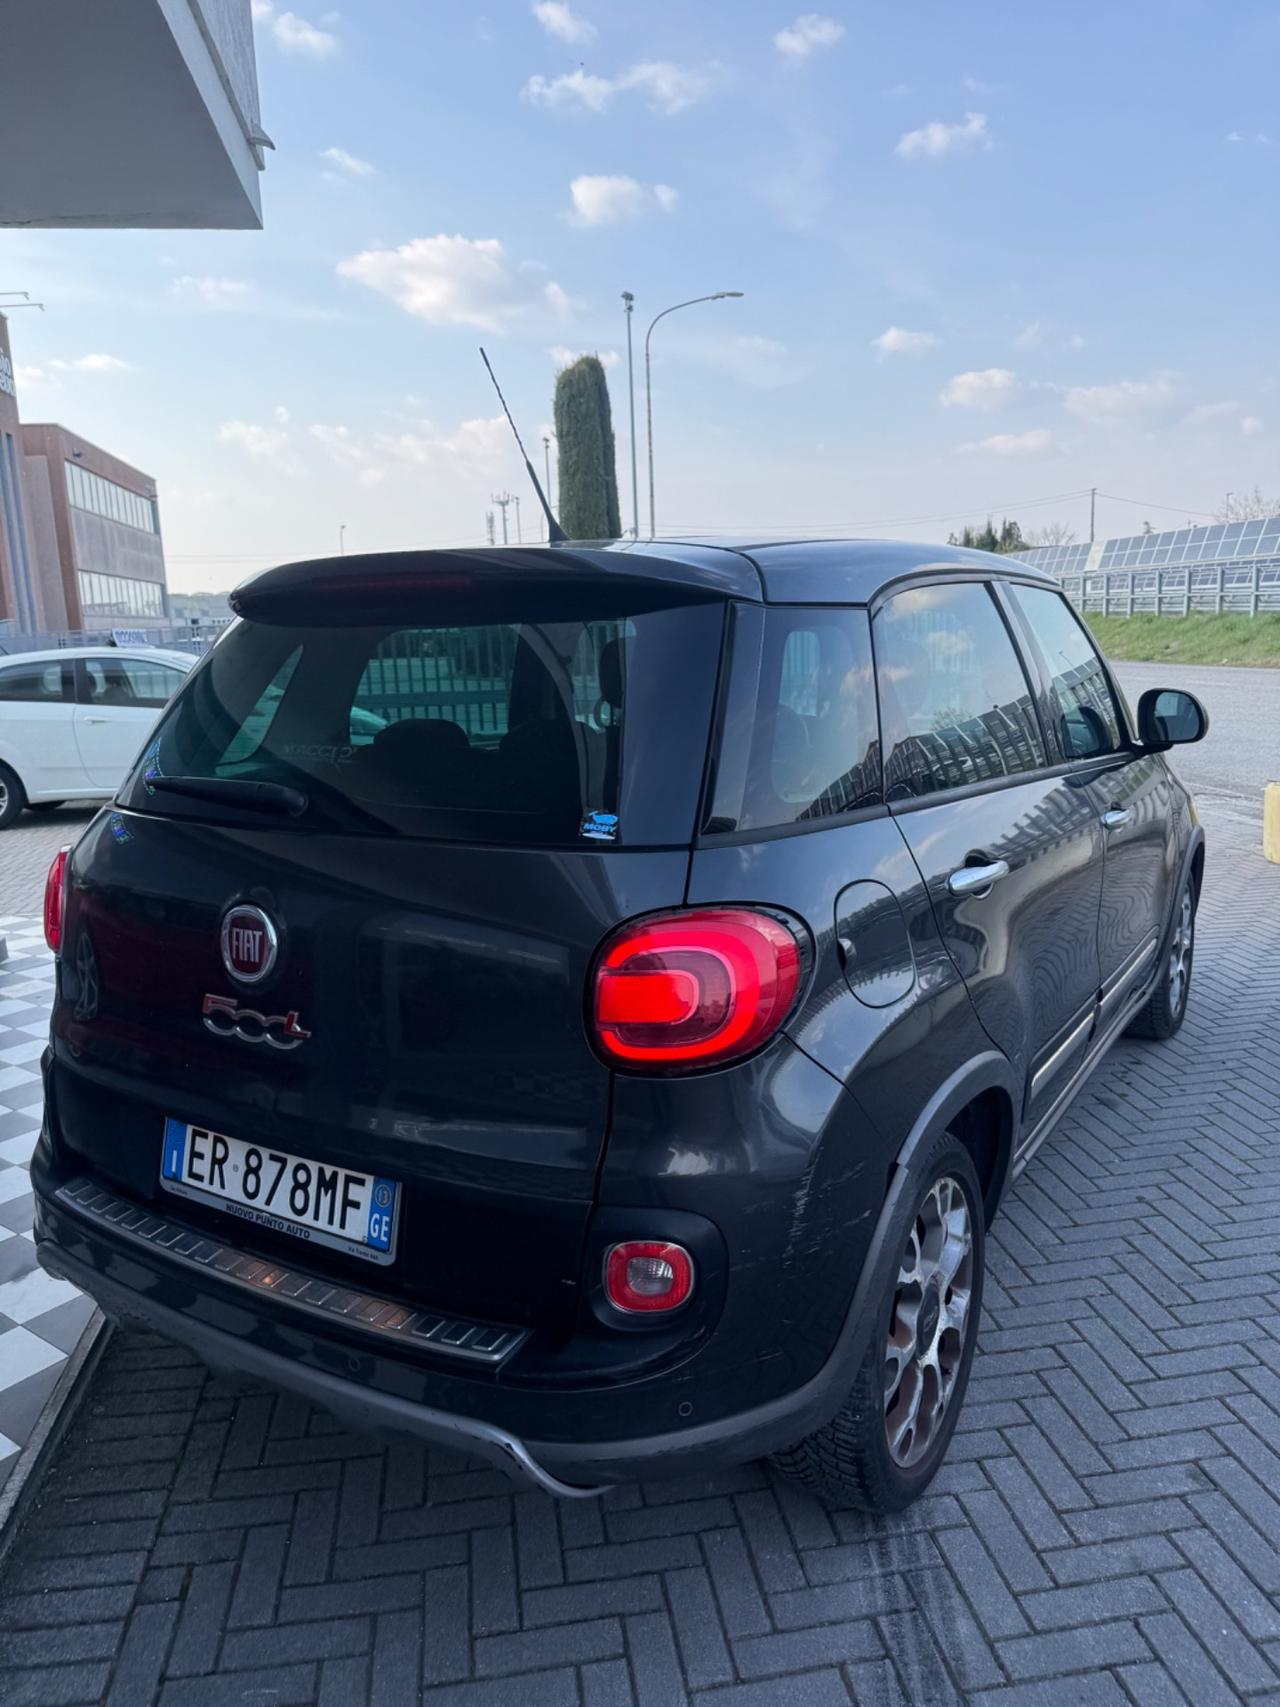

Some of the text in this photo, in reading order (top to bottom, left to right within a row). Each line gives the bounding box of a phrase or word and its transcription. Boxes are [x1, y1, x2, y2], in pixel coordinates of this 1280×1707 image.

[583, 823, 617, 833] MOBY
[231, 927, 263, 963] FIAT
[202, 993, 312, 1050] 500L
[187, 1128, 366, 1230] ER 878MF
[225, 1203, 311, 1239] NUOVO PUNTO AUTO
[370, 1213, 389, 1242] GE
